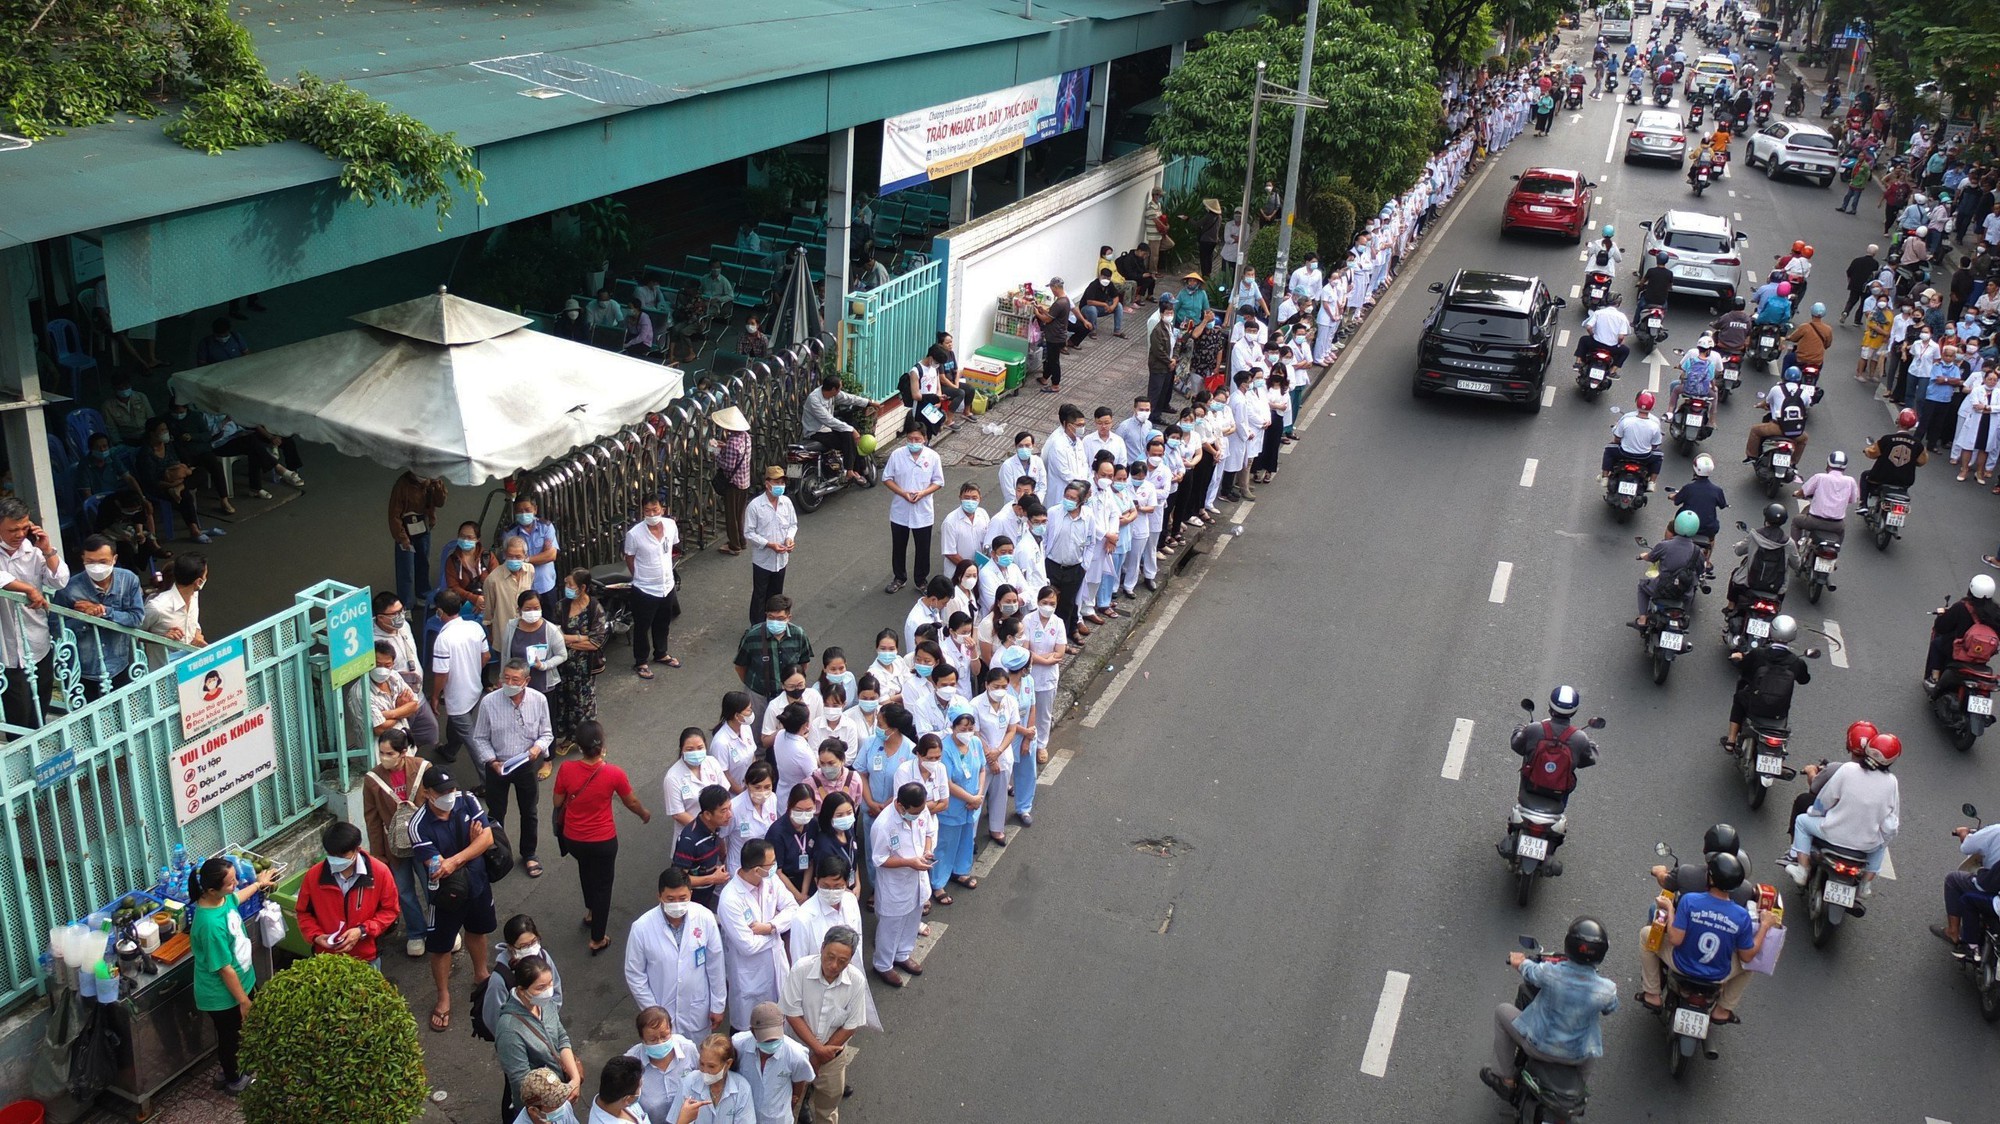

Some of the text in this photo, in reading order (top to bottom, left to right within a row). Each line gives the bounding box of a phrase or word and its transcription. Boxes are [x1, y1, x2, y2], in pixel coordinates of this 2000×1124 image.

[330, 602, 368, 630] CỔNG
[344, 626, 359, 657] 3
[188, 645, 232, 672] THÔNG BÁO
[222, 701, 238, 710] trang
[180, 714, 264, 767] VUI LÒNG KHÔNG
[197, 756, 222, 773] Tụ tập
[200, 770, 227, 788] Đậu xe
[202, 760, 272, 804] Mua bán hàng rong
[1698, 932, 1720, 964] 9
